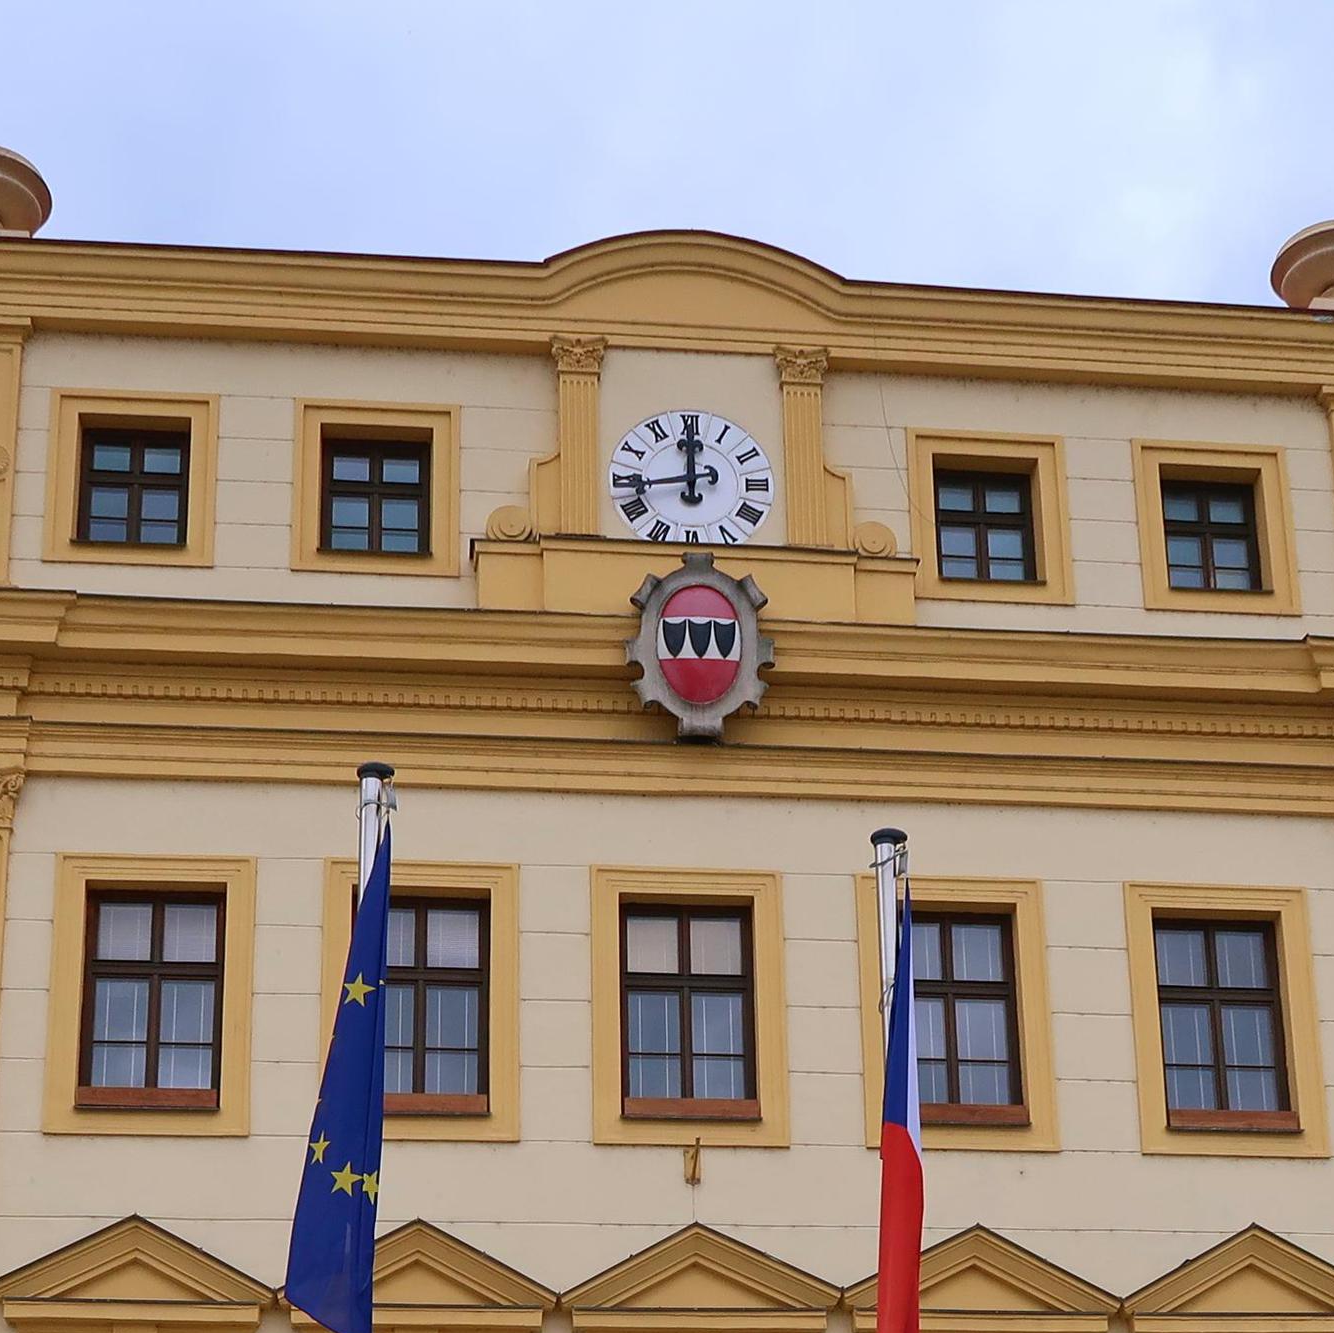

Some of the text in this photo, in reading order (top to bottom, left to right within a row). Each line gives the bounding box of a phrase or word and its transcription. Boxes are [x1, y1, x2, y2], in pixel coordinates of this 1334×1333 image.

[645, 419, 669, 443] XI
[715, 424, 731, 444] I
[621, 441, 646, 461] X
[736, 447, 760, 465] II
[746, 478, 769, 492] III
[620, 497, 649, 523] VIII
[736, 502, 764, 526] IIII
